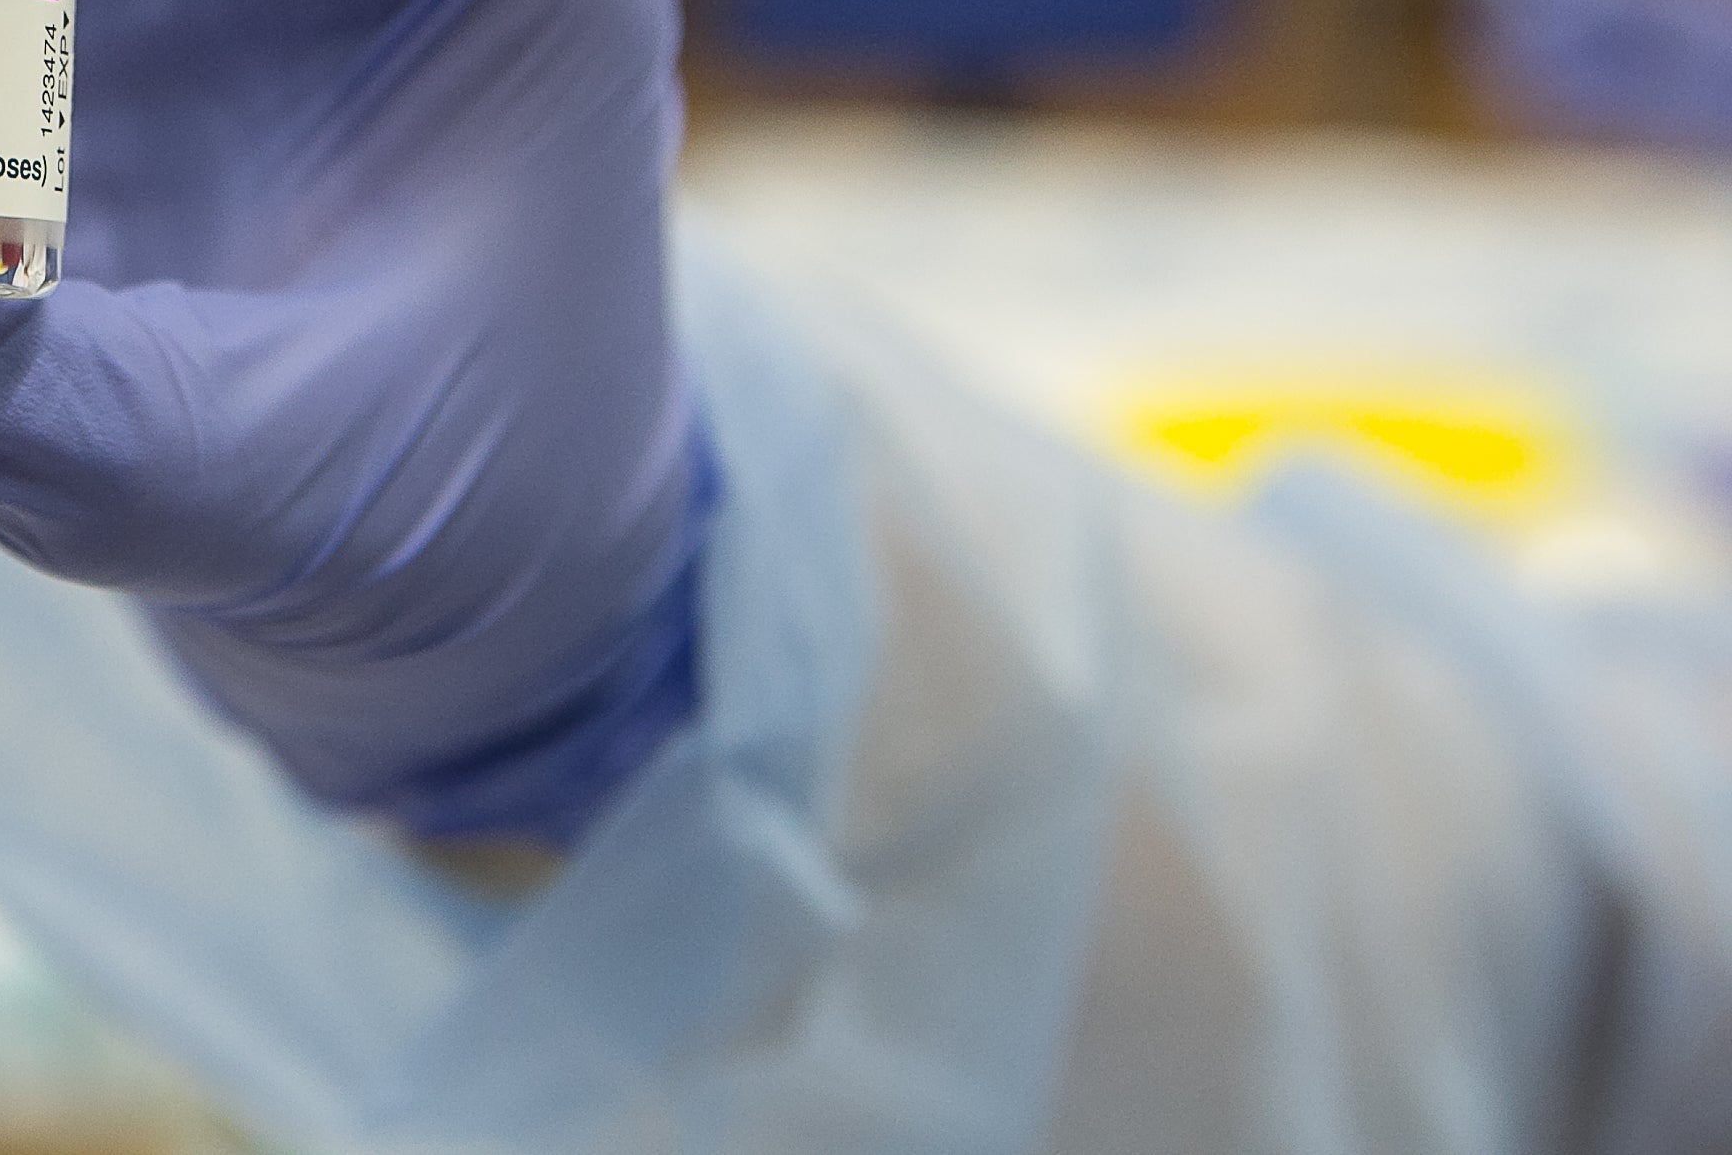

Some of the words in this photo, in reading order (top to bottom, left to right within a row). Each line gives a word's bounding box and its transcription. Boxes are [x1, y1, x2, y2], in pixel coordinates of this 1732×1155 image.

[41, 23, 57, 137] 1423474
[58, 35, 69, 100] EXP
[54, 147, 65, 192] Lot
